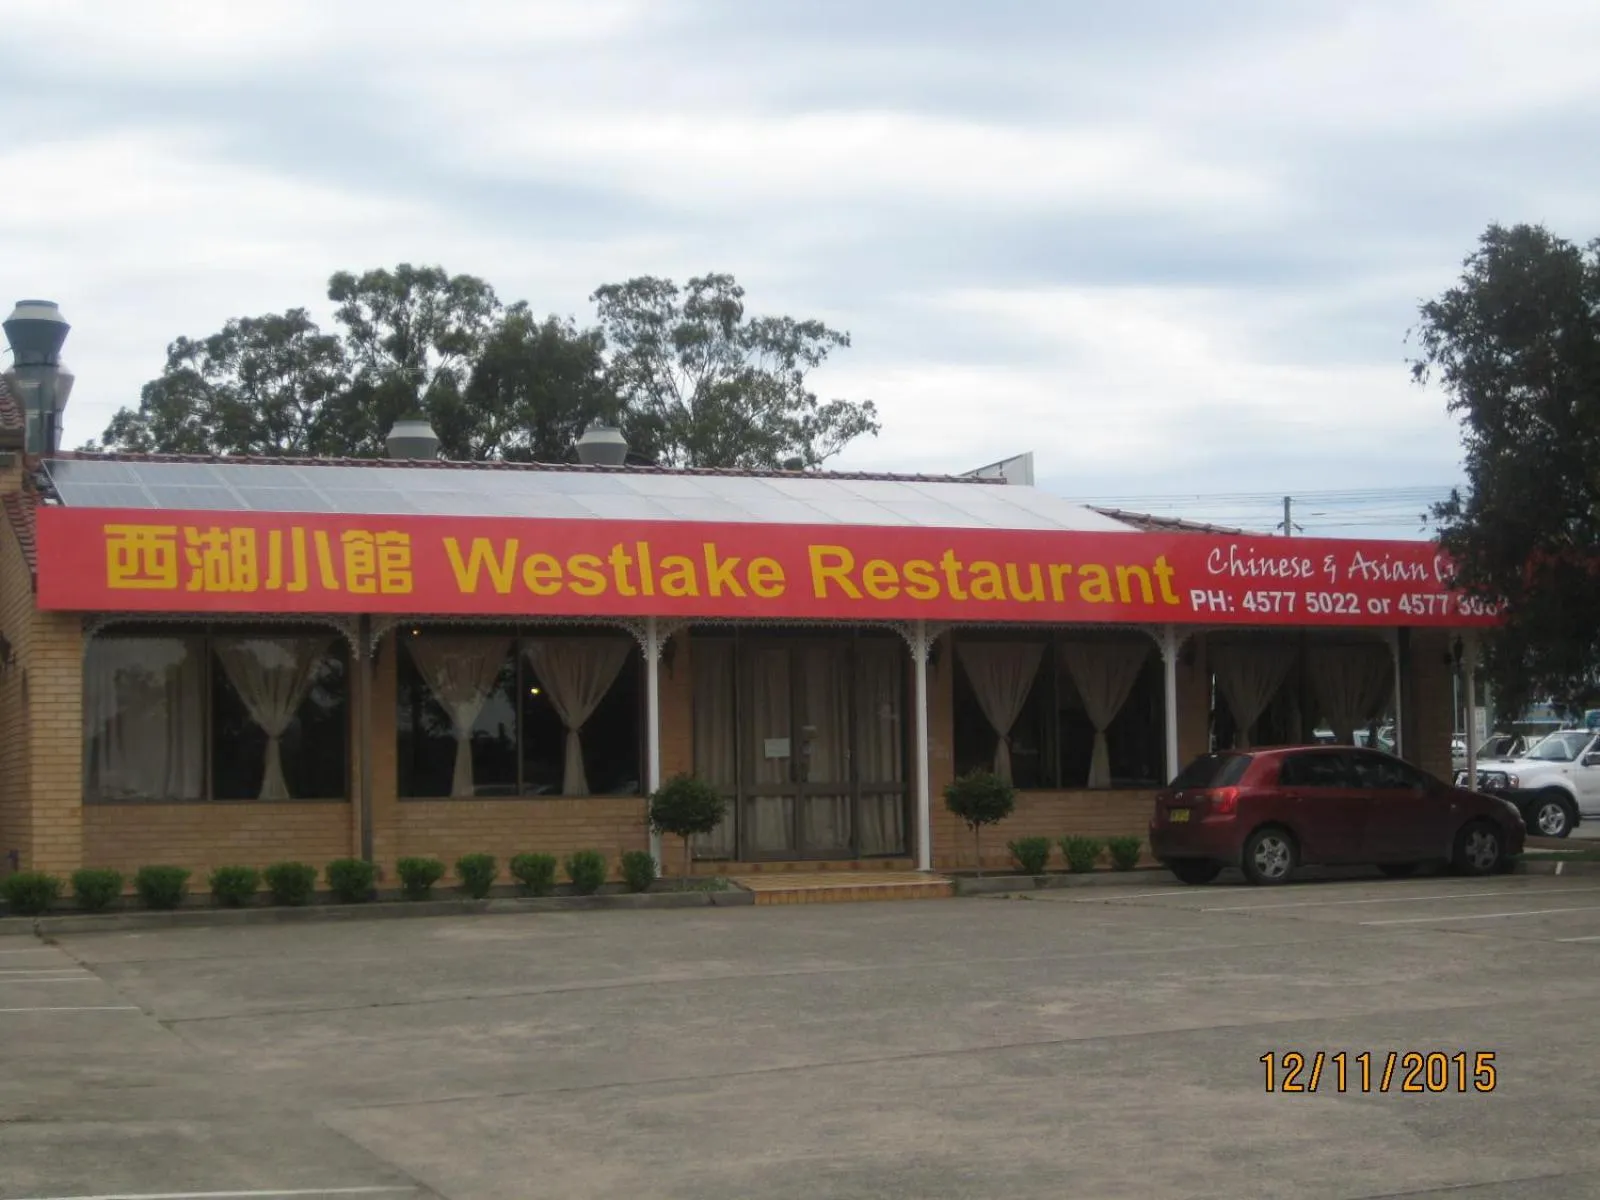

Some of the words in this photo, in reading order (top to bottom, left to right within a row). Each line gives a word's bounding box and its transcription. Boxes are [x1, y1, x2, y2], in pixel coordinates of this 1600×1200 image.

[104, 524, 413, 593] 西湖小館
[444, 537, 785, 598] Westlake
[808, 544, 1180, 605] Restaurant
[1207, 544, 1313, 578] Chinese
[1323, 554, 1337, 585] &
[1347, 551, 1429, 582] Asian
[1190, 590, 1235, 613] PH:
[1242, 591, 1296, 613] 4577
[1305, 592, 1361, 614] 5022
[1367, 598, 1390, 614] or
[1398, 593, 1449, 615] 4577
